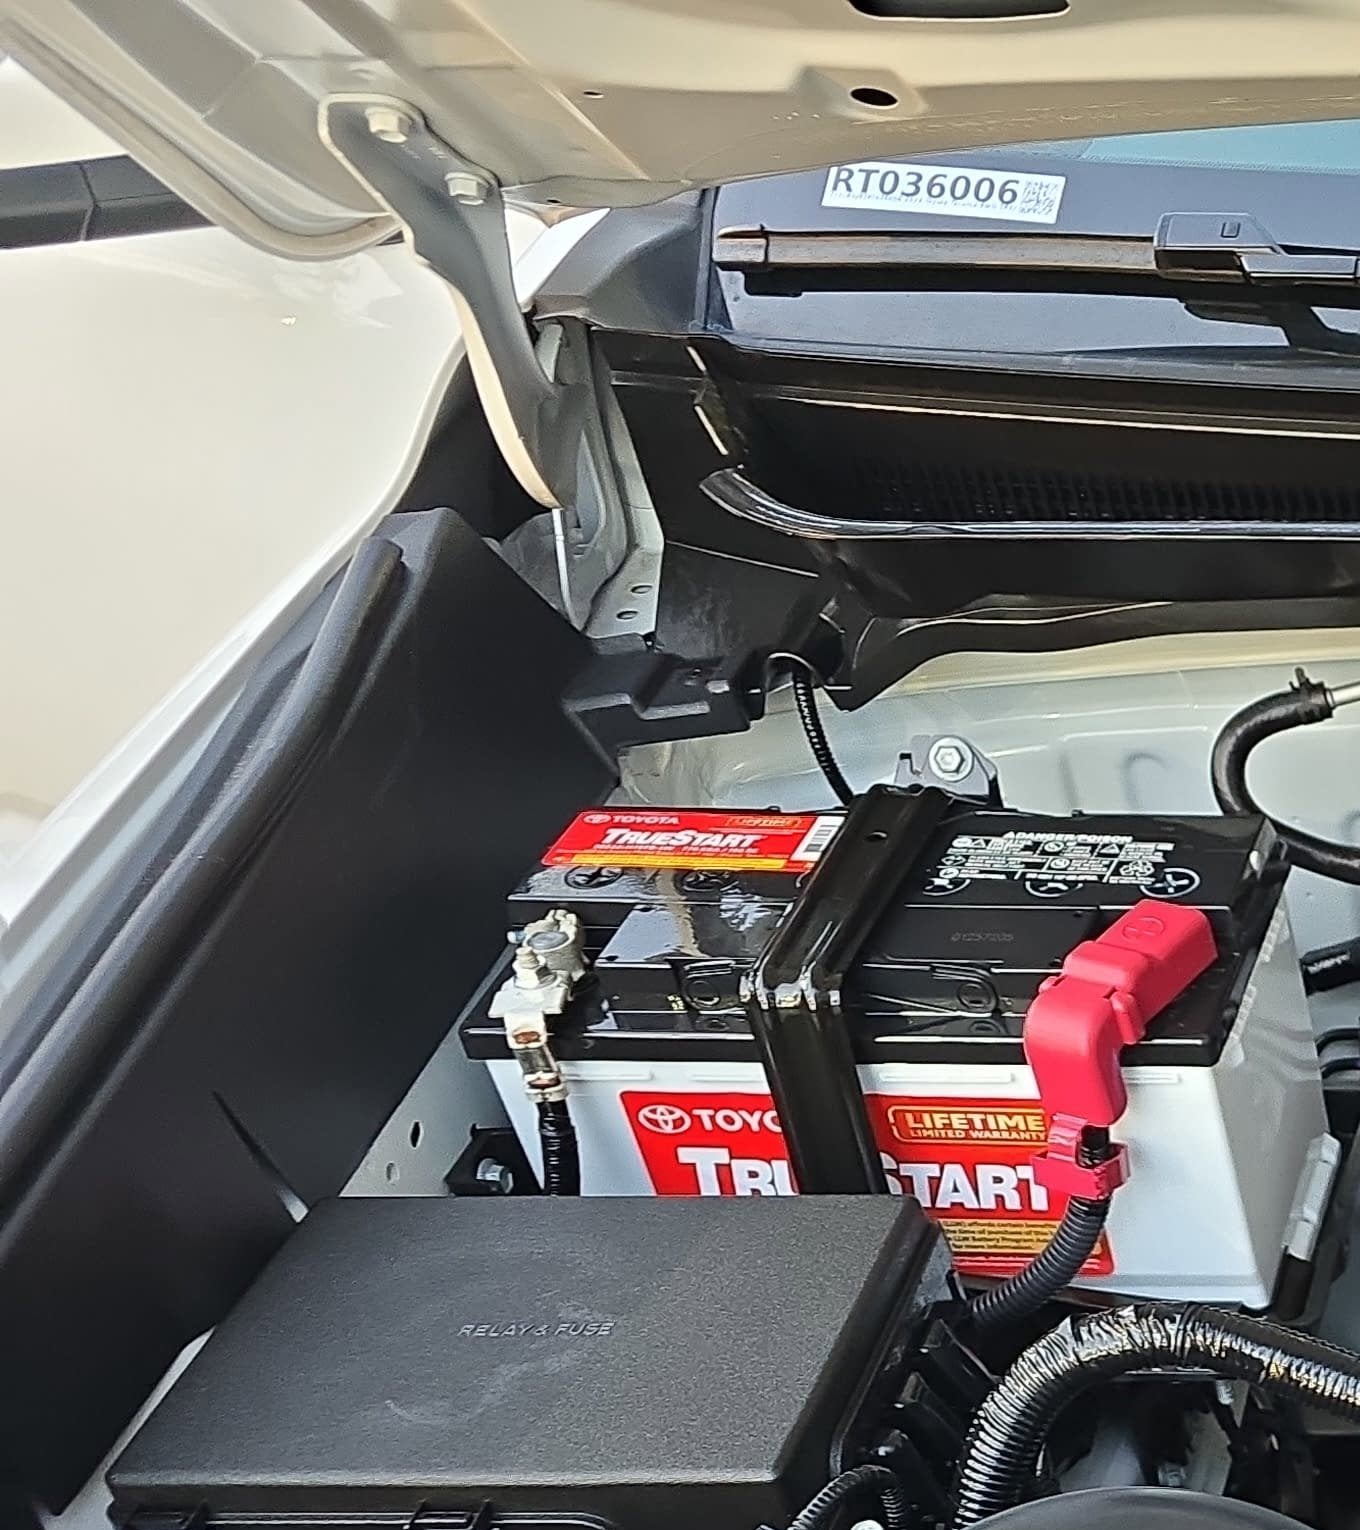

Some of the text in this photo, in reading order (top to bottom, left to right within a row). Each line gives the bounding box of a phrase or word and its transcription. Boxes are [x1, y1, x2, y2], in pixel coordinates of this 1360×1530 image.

[831, 167, 1022, 206] RT036006
[611, 815, 680, 825] TOYOTA
[692, 1109, 783, 1132] TOYO
[905, 1111, 1046, 1131] LIFETIME
[910, 1129, 966, 1140] LIMITED
[456, 1324, 535, 1338] RELAY
[553, 1321, 618, 1337] FUSE
